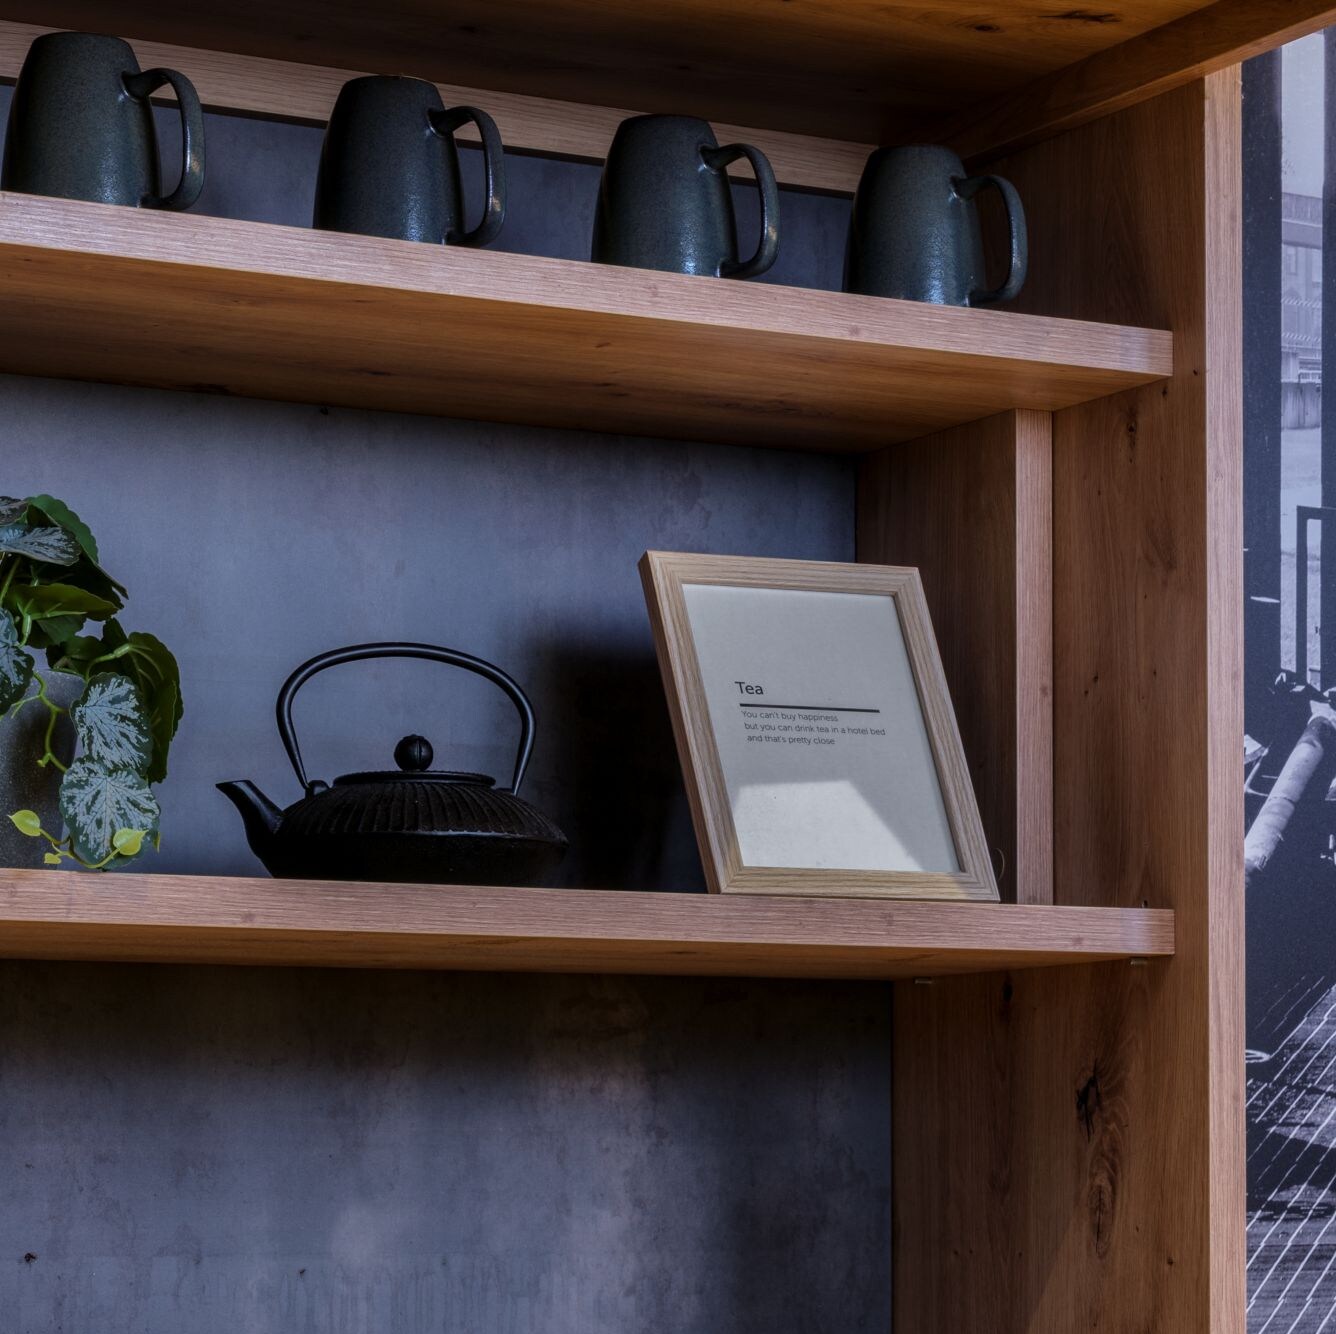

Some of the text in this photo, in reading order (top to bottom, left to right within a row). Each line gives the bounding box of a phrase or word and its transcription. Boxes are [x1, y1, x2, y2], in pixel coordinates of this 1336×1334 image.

[735, 681, 764, 695] Tea
[741, 710, 838, 722] You can't buy happiness
[744, 722, 758, 730] but
[760, 724, 776, 732] you
[778, 724, 793, 732] can
[794, 724, 814, 733] drink
[831, 726, 839, 734] in
[847, 727, 869, 735] hotel
[870, 728, 886, 736] bed
[747, 734, 836, 745] and that's pretty close
